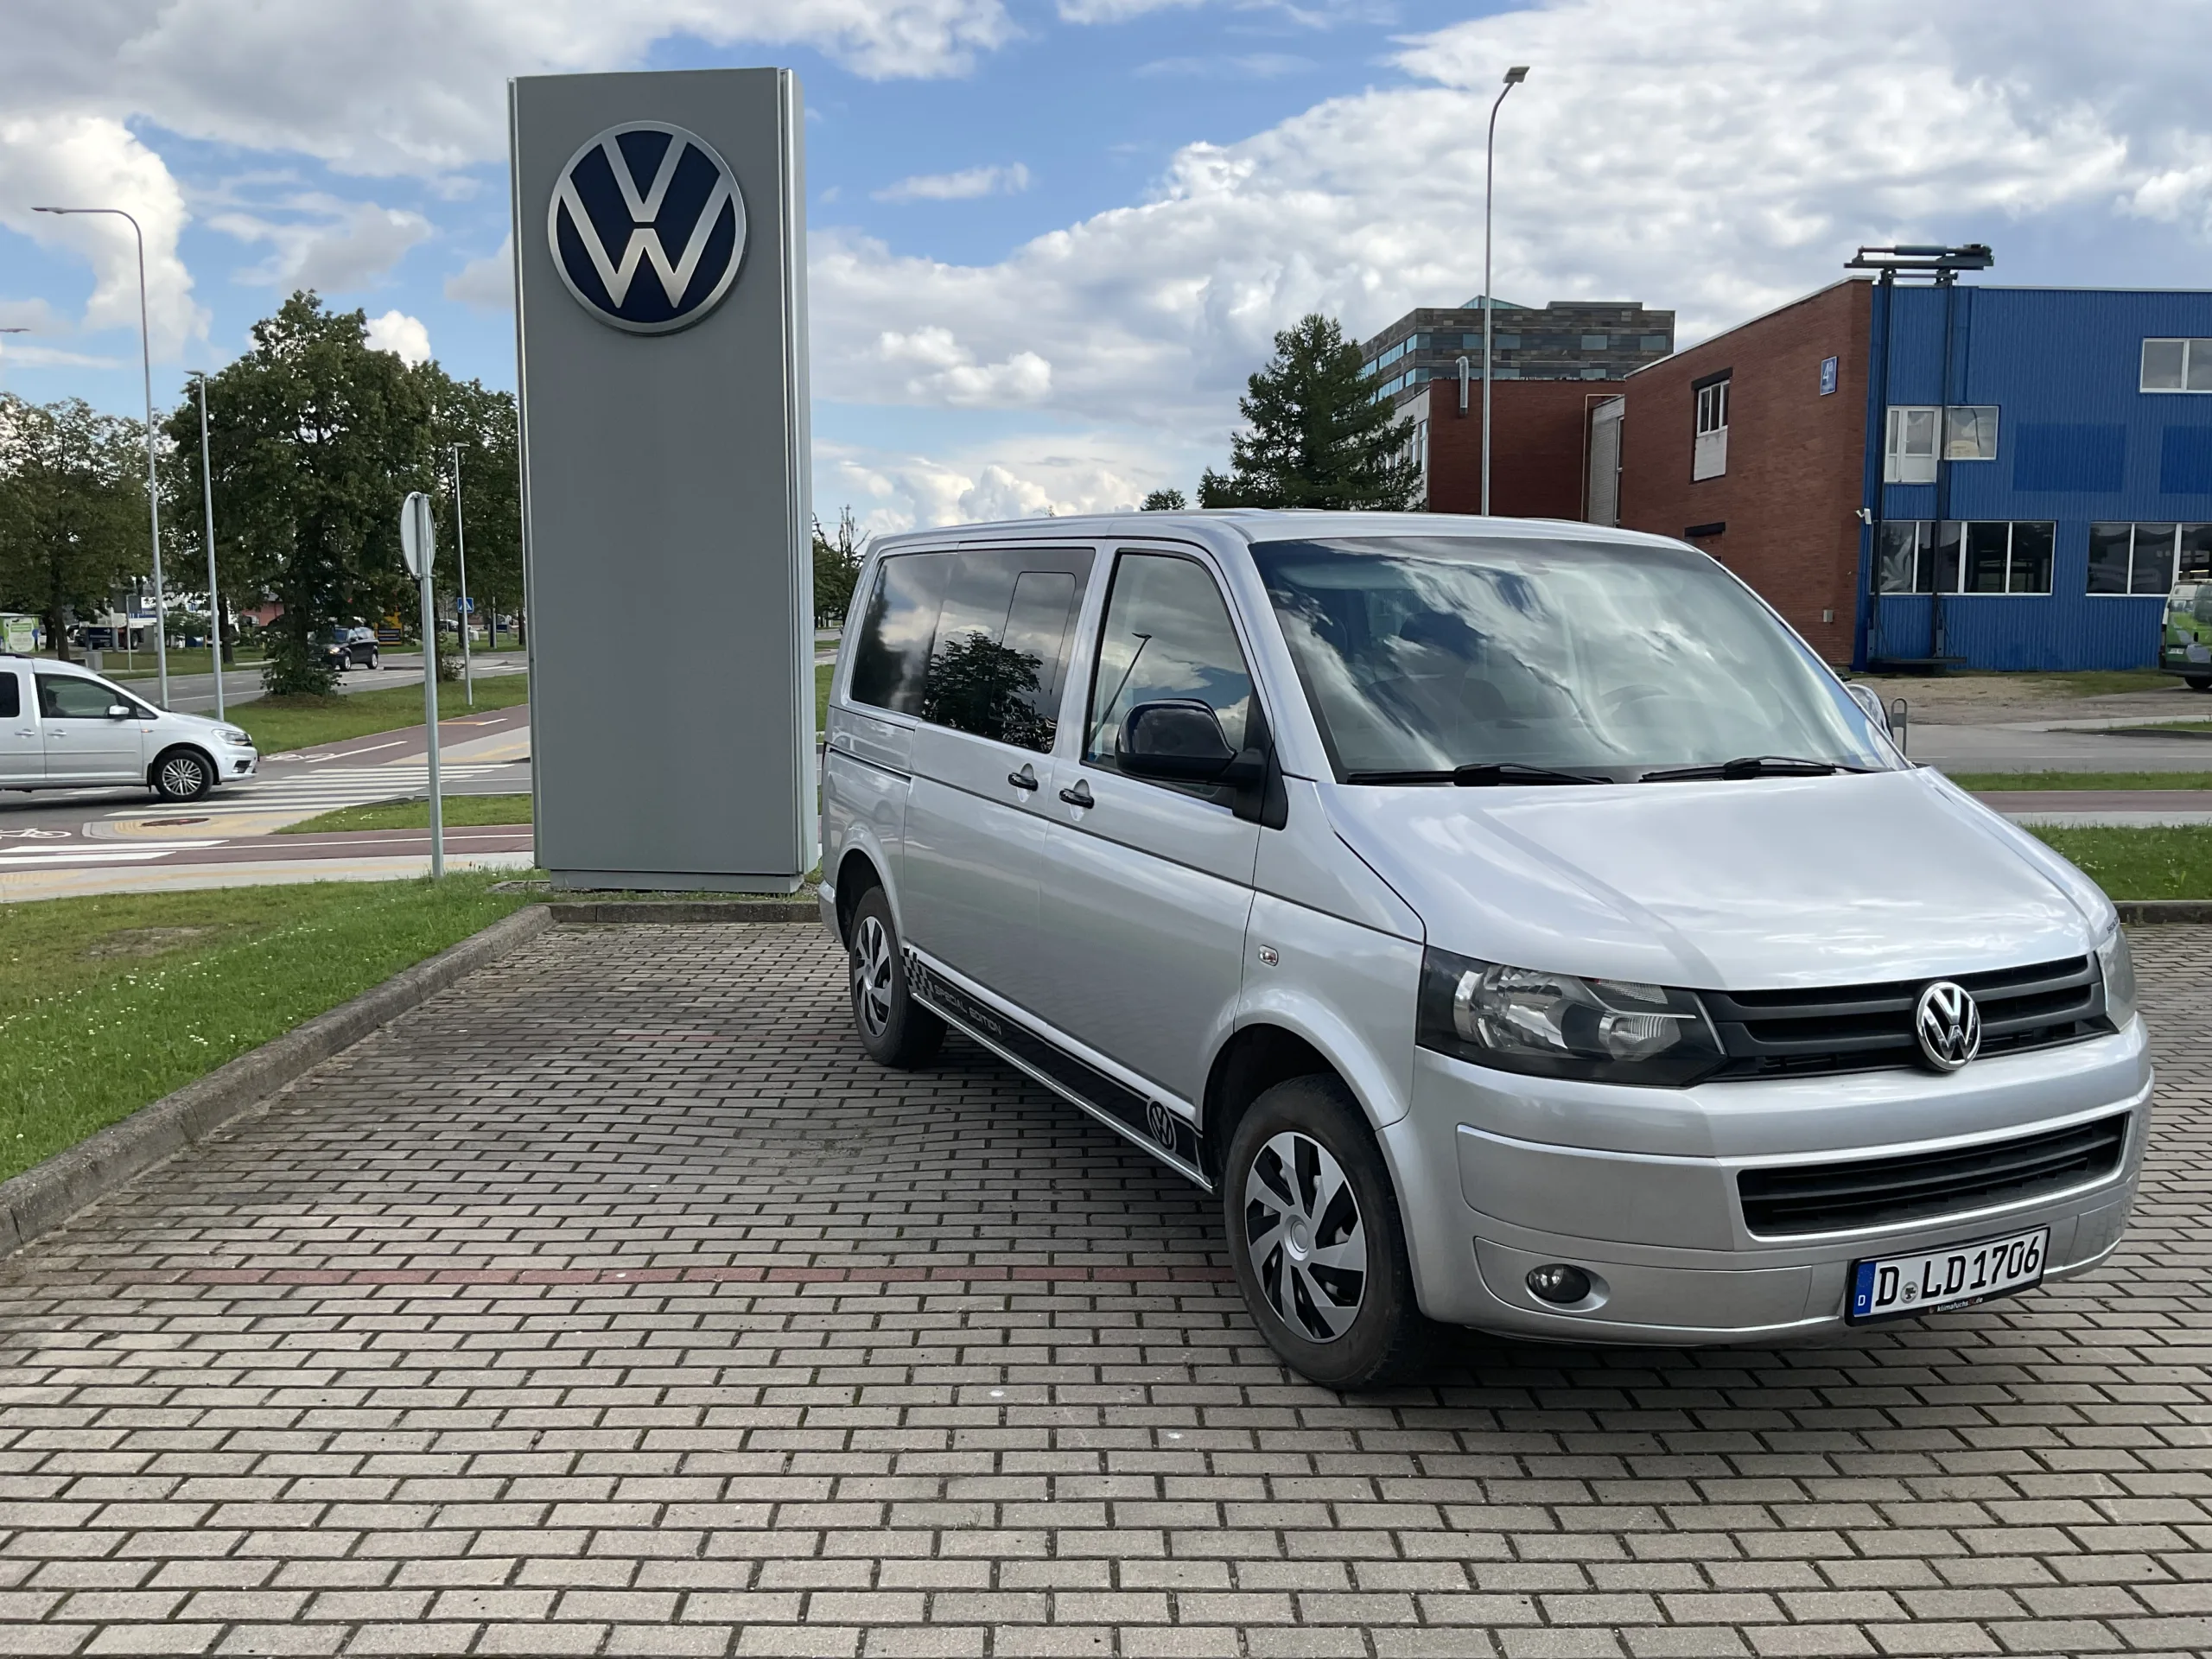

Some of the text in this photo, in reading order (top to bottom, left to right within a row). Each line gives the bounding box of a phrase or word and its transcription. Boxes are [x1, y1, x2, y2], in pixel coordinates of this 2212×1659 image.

[550, 122, 745, 332] VW
[934, 984, 1002, 1036] SPECIAL EDITION
[1916, 982, 1980, 1070] VW
[1857, 1294, 1866, 1306] D
[1875, 1266, 1900, 1306] D
